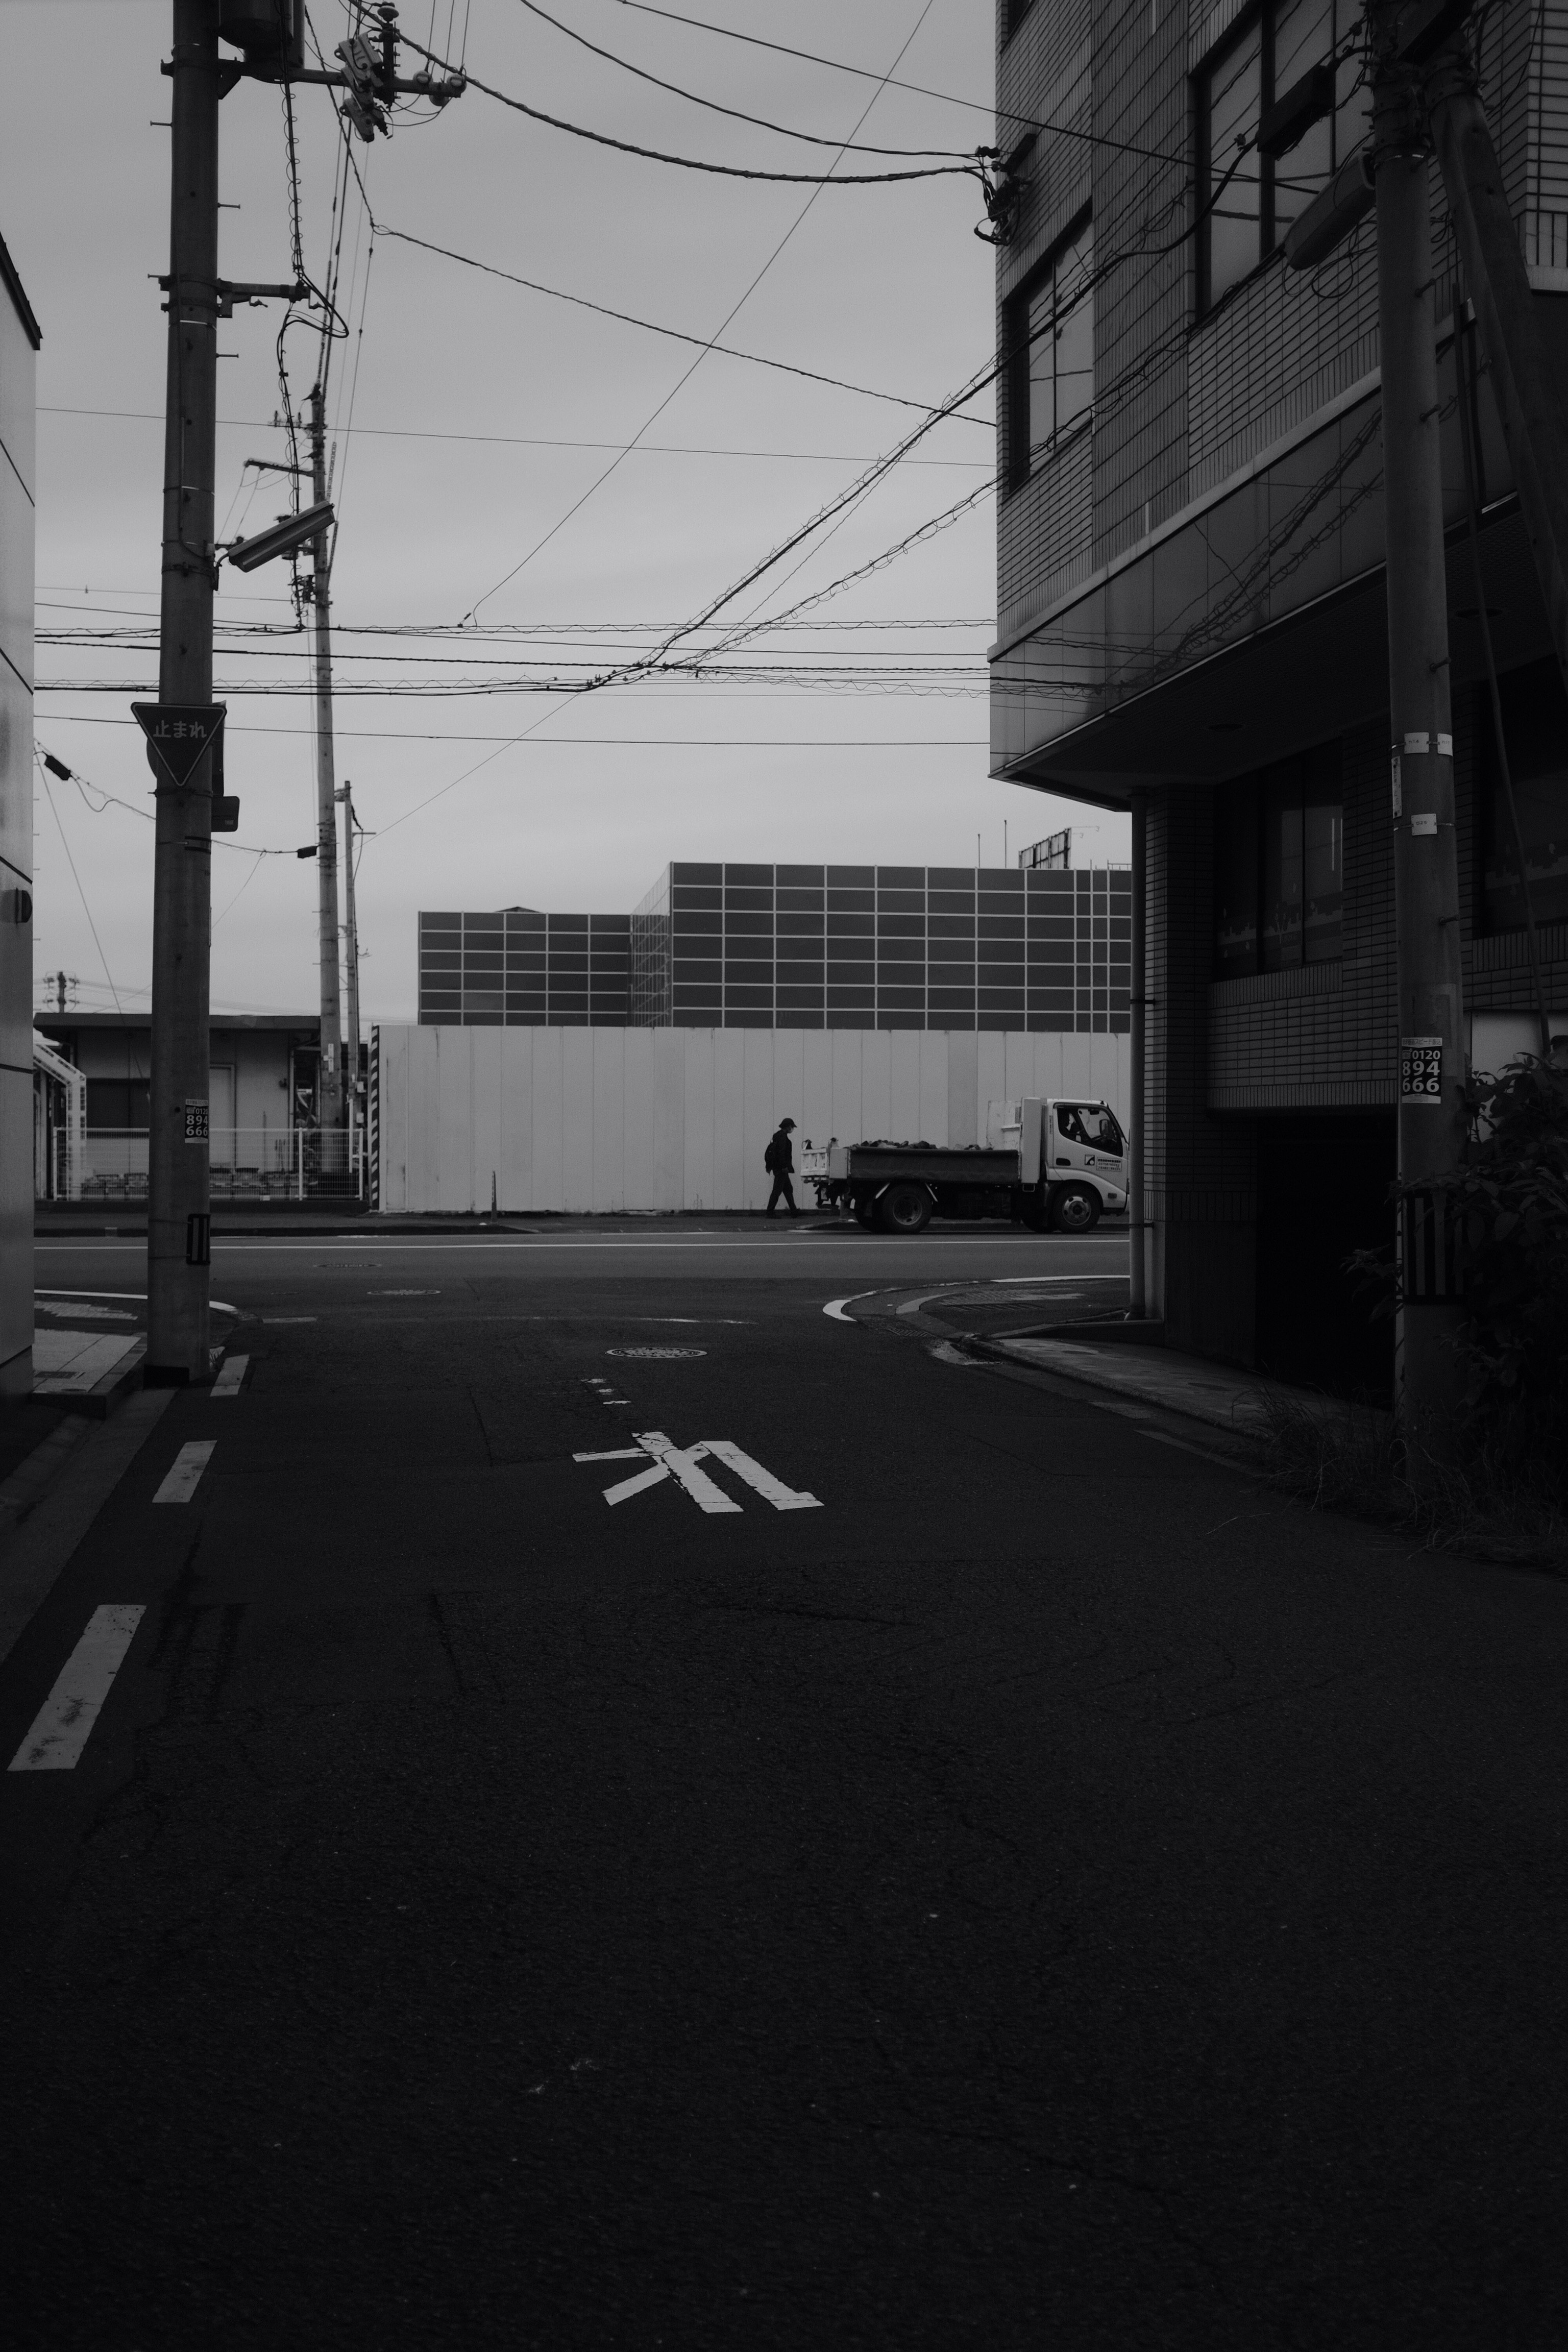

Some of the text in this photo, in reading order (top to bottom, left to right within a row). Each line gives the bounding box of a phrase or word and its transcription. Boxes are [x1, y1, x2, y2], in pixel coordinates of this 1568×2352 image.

[153, 720, 207, 739] 止まれ
[1412, 1050, 1441, 1060] 0120
[1402, 1061, 1440, 1076] 894
[1402, 1077, 1440, 1093] 666
[186, 1115, 208, 1125] 894
[186, 1125, 208, 1136] 666
